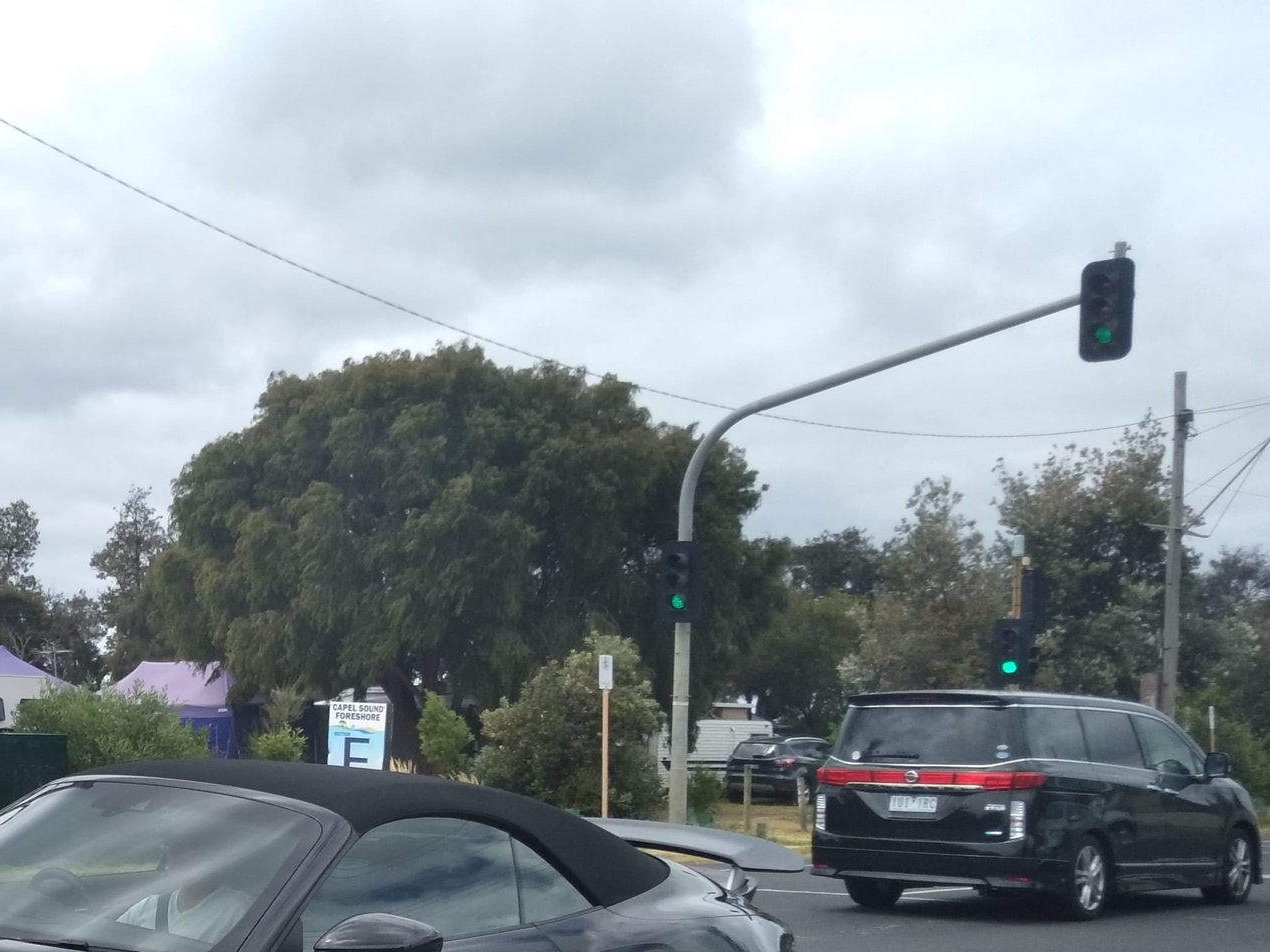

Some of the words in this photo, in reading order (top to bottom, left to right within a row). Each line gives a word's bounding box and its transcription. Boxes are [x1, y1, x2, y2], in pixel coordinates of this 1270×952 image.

[332, 703, 357, 713] CAPEL
[358, 704, 384, 713] SOUND
[335, 712, 381, 721] FORESHORE
